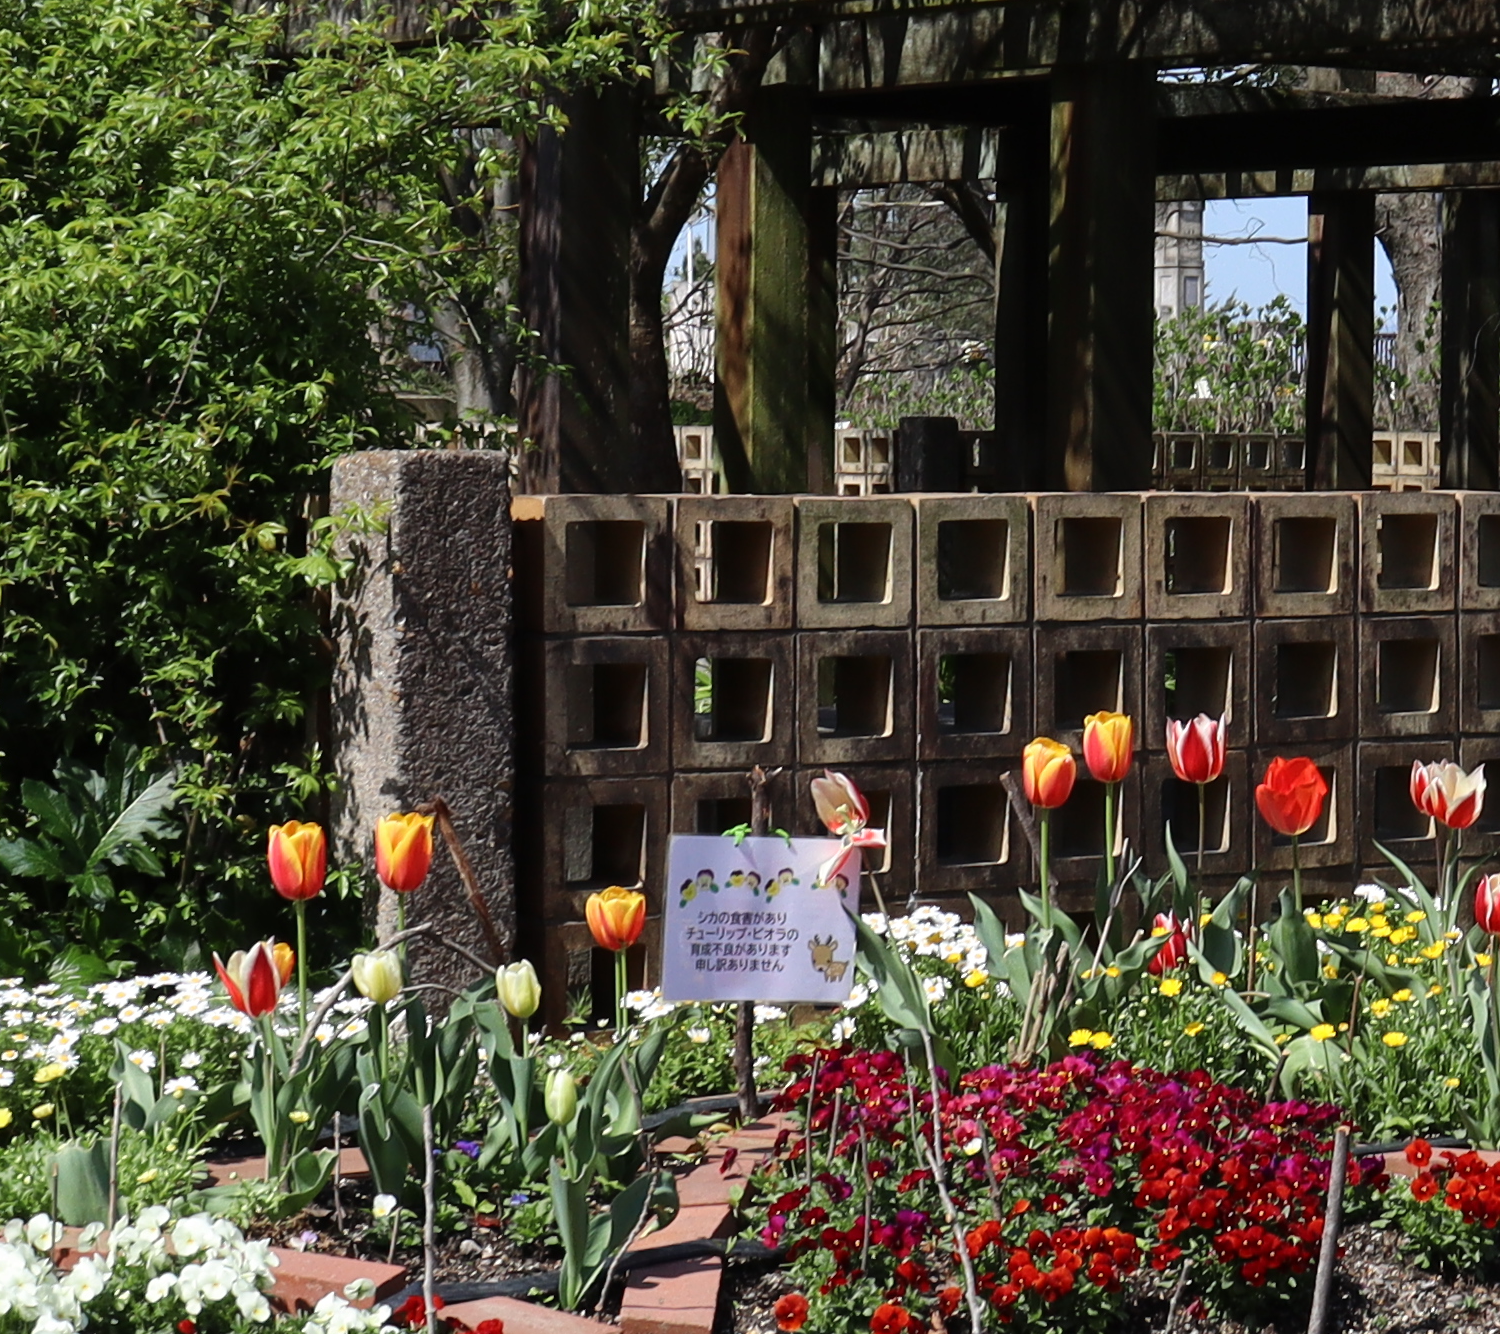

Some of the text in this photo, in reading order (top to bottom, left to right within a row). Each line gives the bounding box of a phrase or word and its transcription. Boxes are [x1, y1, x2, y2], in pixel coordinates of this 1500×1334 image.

[698, 911, 787, 925] シカの食害があり
[690, 943, 792, 957] 育成不良があります
[695, 958, 785, 972] 申し訳ありません
